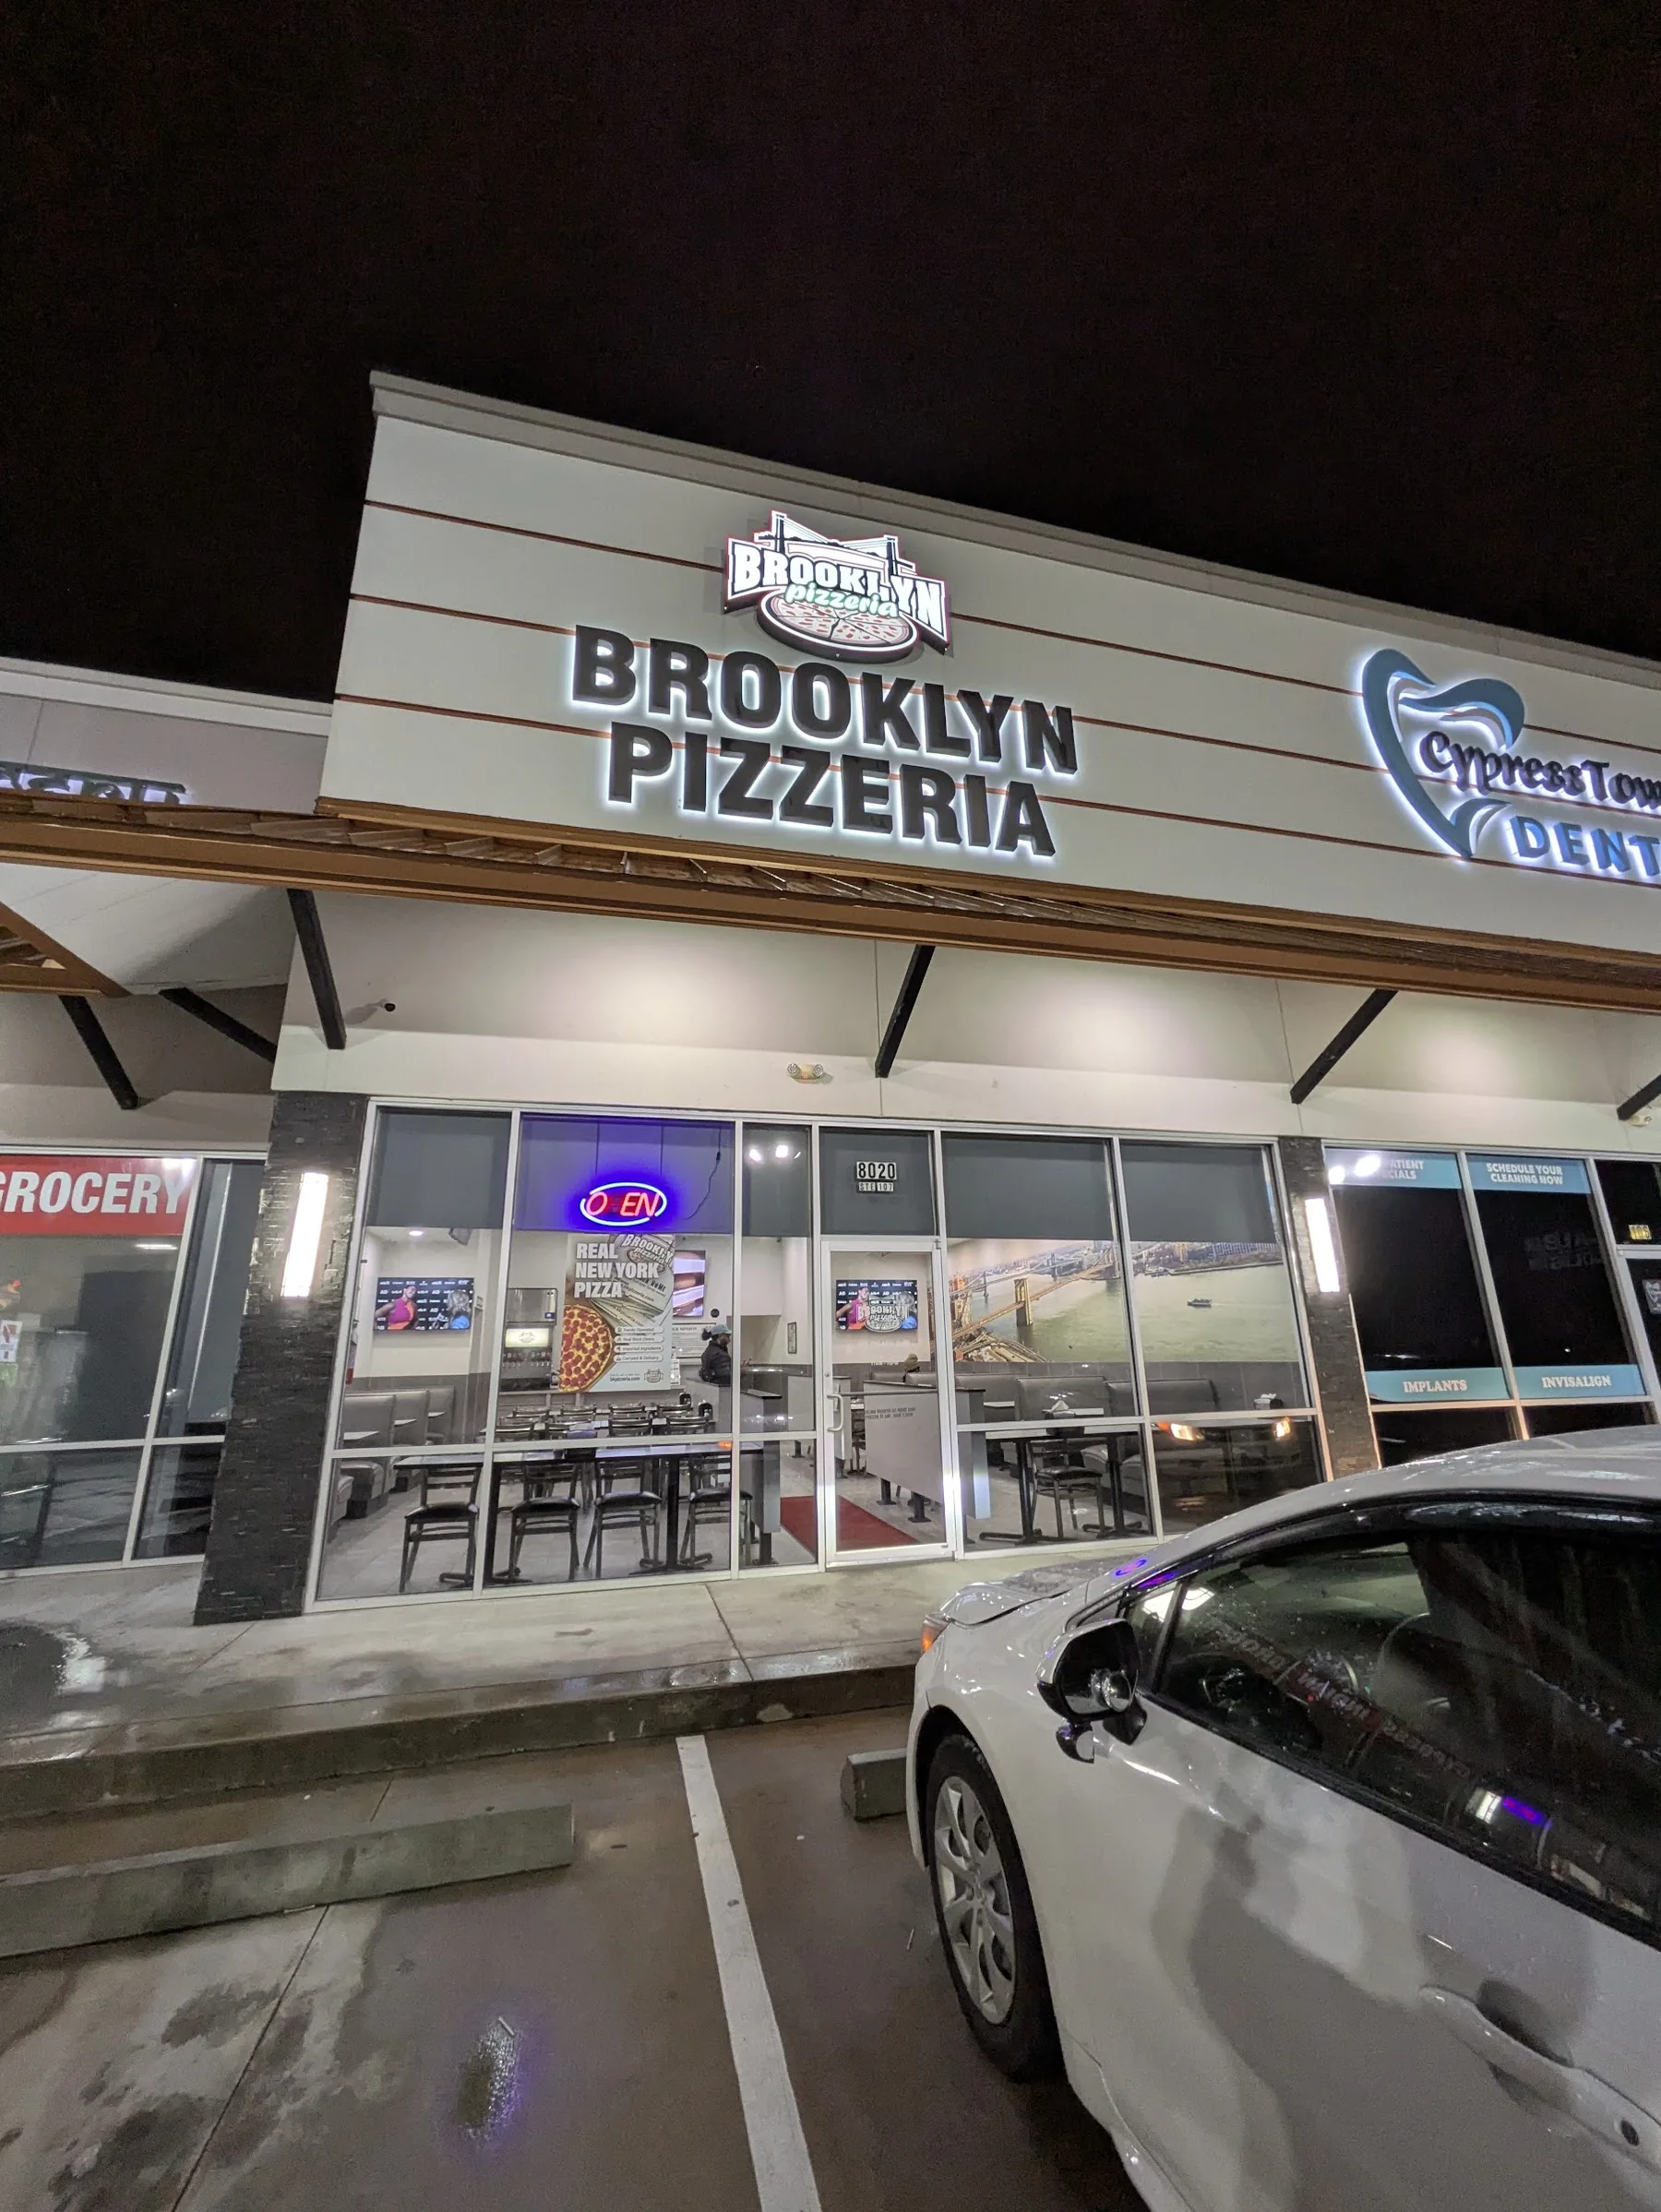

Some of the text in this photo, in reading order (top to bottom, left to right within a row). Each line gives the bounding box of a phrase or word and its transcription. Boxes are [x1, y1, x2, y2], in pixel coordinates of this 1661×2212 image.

[734, 543, 943, 637] BROOKLYN
[785, 582, 899, 617] pizzeria
[573, 624, 1078, 774] BROOKLYN
[608, 721, 1057, 856] PIZZERIA
[1510, 816, 1661, 876] DENT
[858, 1163, 895, 1178] 8020
[1487, 1163, 1563, 1176] SCHEDULE YOUR
[859, 1182, 875, 1190] STE
[1490, 1173, 1563, 1185] CLEANING NOW
[0, 1170, 188, 1214] ROCERY
[586, 1191, 660, 1217] OEN
[576, 1242, 618, 1259] REAL
[575, 1261, 659, 1279] NEW YORK
[574, 1281, 623, 1298] PIZZA
[1403, 1379, 1467, 1393] IMPLANTS
[1542, 1375, 1612, 1389] INVISALIGN
